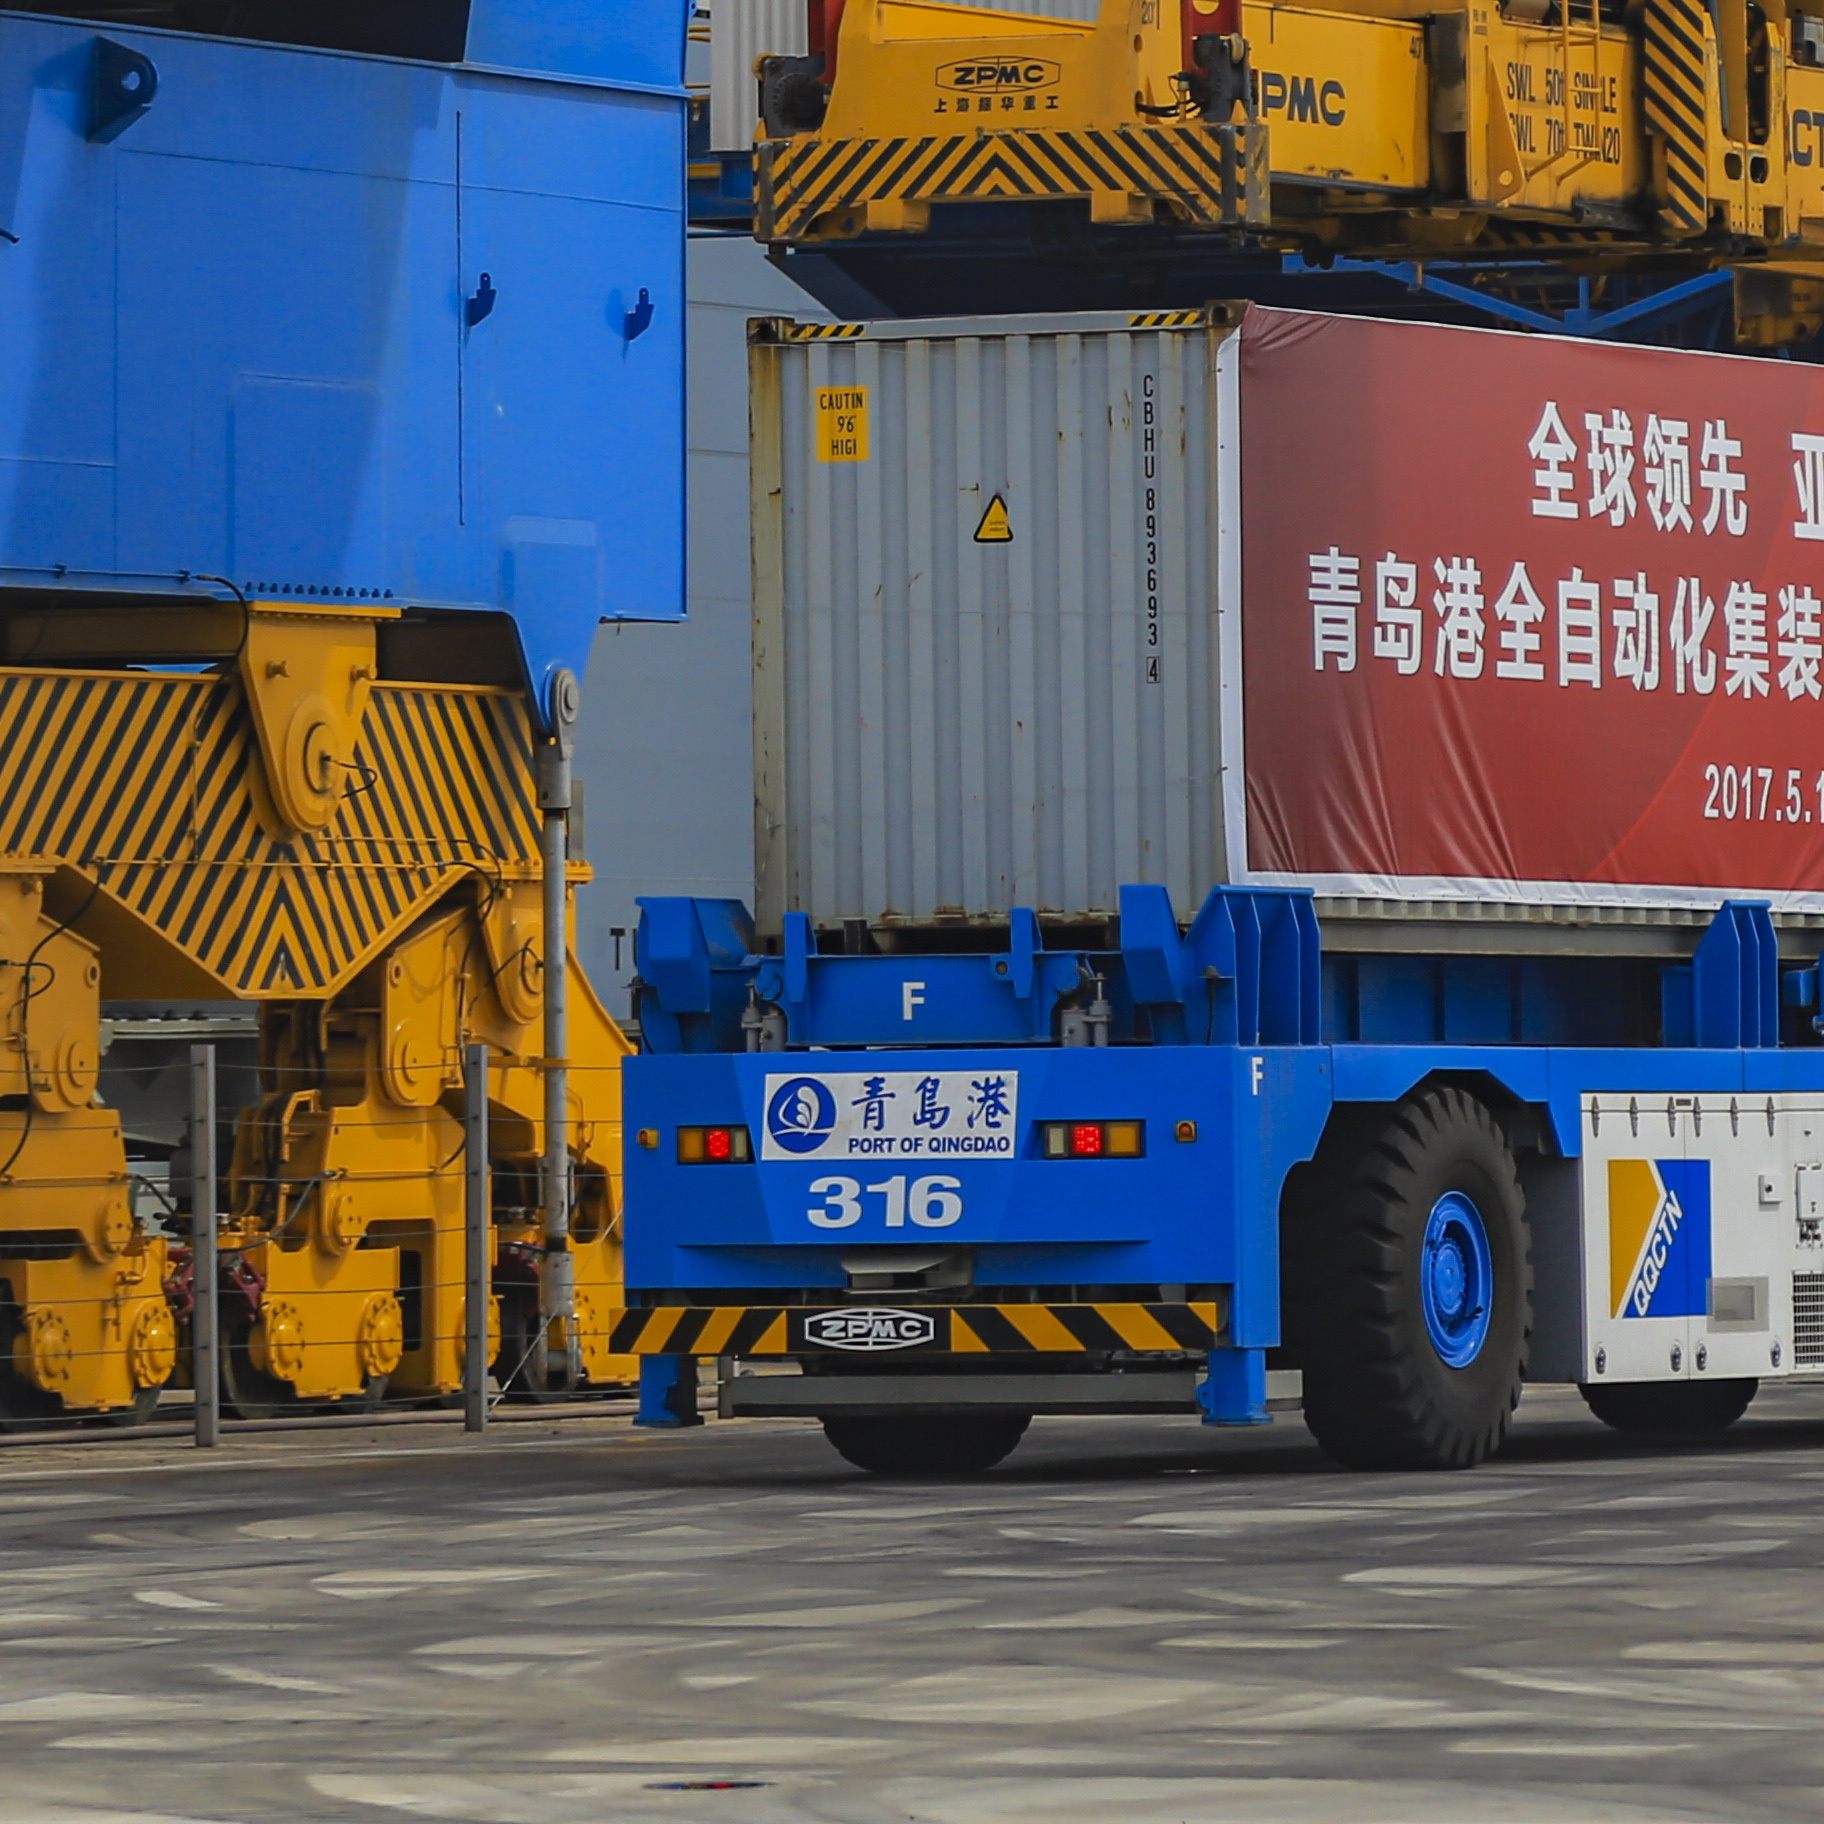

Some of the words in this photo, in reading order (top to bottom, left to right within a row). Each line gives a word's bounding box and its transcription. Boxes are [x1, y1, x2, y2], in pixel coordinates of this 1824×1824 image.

[953, 64, 1045, 86] ZPMC
[1259, 71, 1346, 127] PMC
[1507, 61, 1537, 103] SWL
[1573, 72, 1617, 114] SINLE
[1142, 374, 1156, 479] CBHU
[1528, 399, 1749, 538] 全球领先
[1145, 487, 1158, 647] 893693
[1147, 657, 1160, 683] 4
[609, 927, 639, 972] T
[901, 980, 926, 1021] F
[1250, 1056, 1264, 1096] F
[847, 1137, 897, 1154] PORT
[900, 1136, 924, 1153] OF
[928, 1136, 1010, 1154] QINGDAO
[806, 1174, 963, 1229] 316
[1633, 1189, 1684, 1317] QQCTN
[820, 1319, 922, 1338] ZPMC
